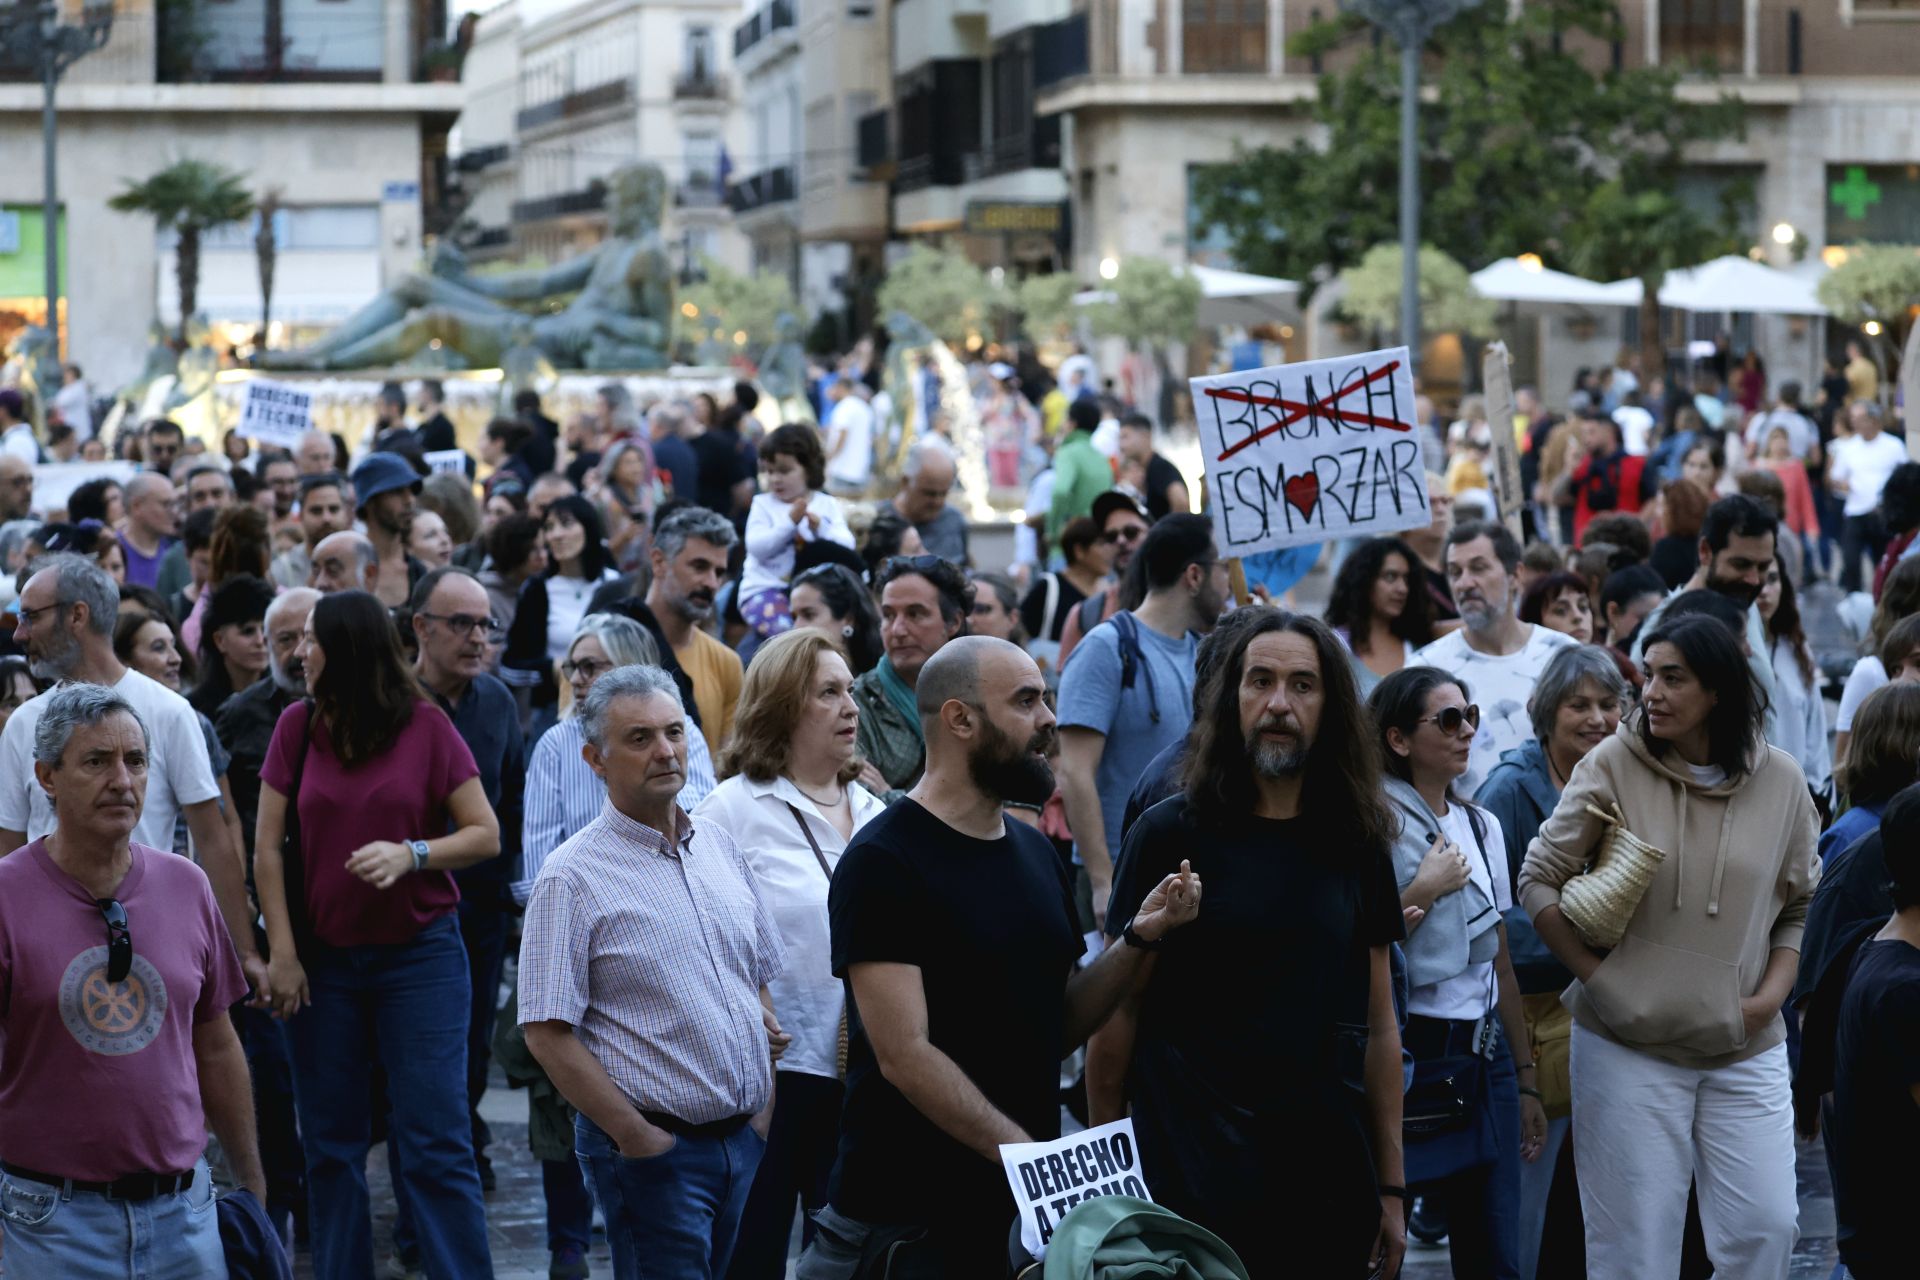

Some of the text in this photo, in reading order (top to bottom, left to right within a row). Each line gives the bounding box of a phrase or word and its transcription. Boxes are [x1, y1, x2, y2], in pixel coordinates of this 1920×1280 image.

[250, 384, 309, 409] DERECHO
[1211, 362, 1400, 452] BRUNCH
[245, 404, 306, 428] A TECHO
[76, 1024, 154, 1051] ICELAND
[1018, 1132, 1134, 1202] DERECHO
